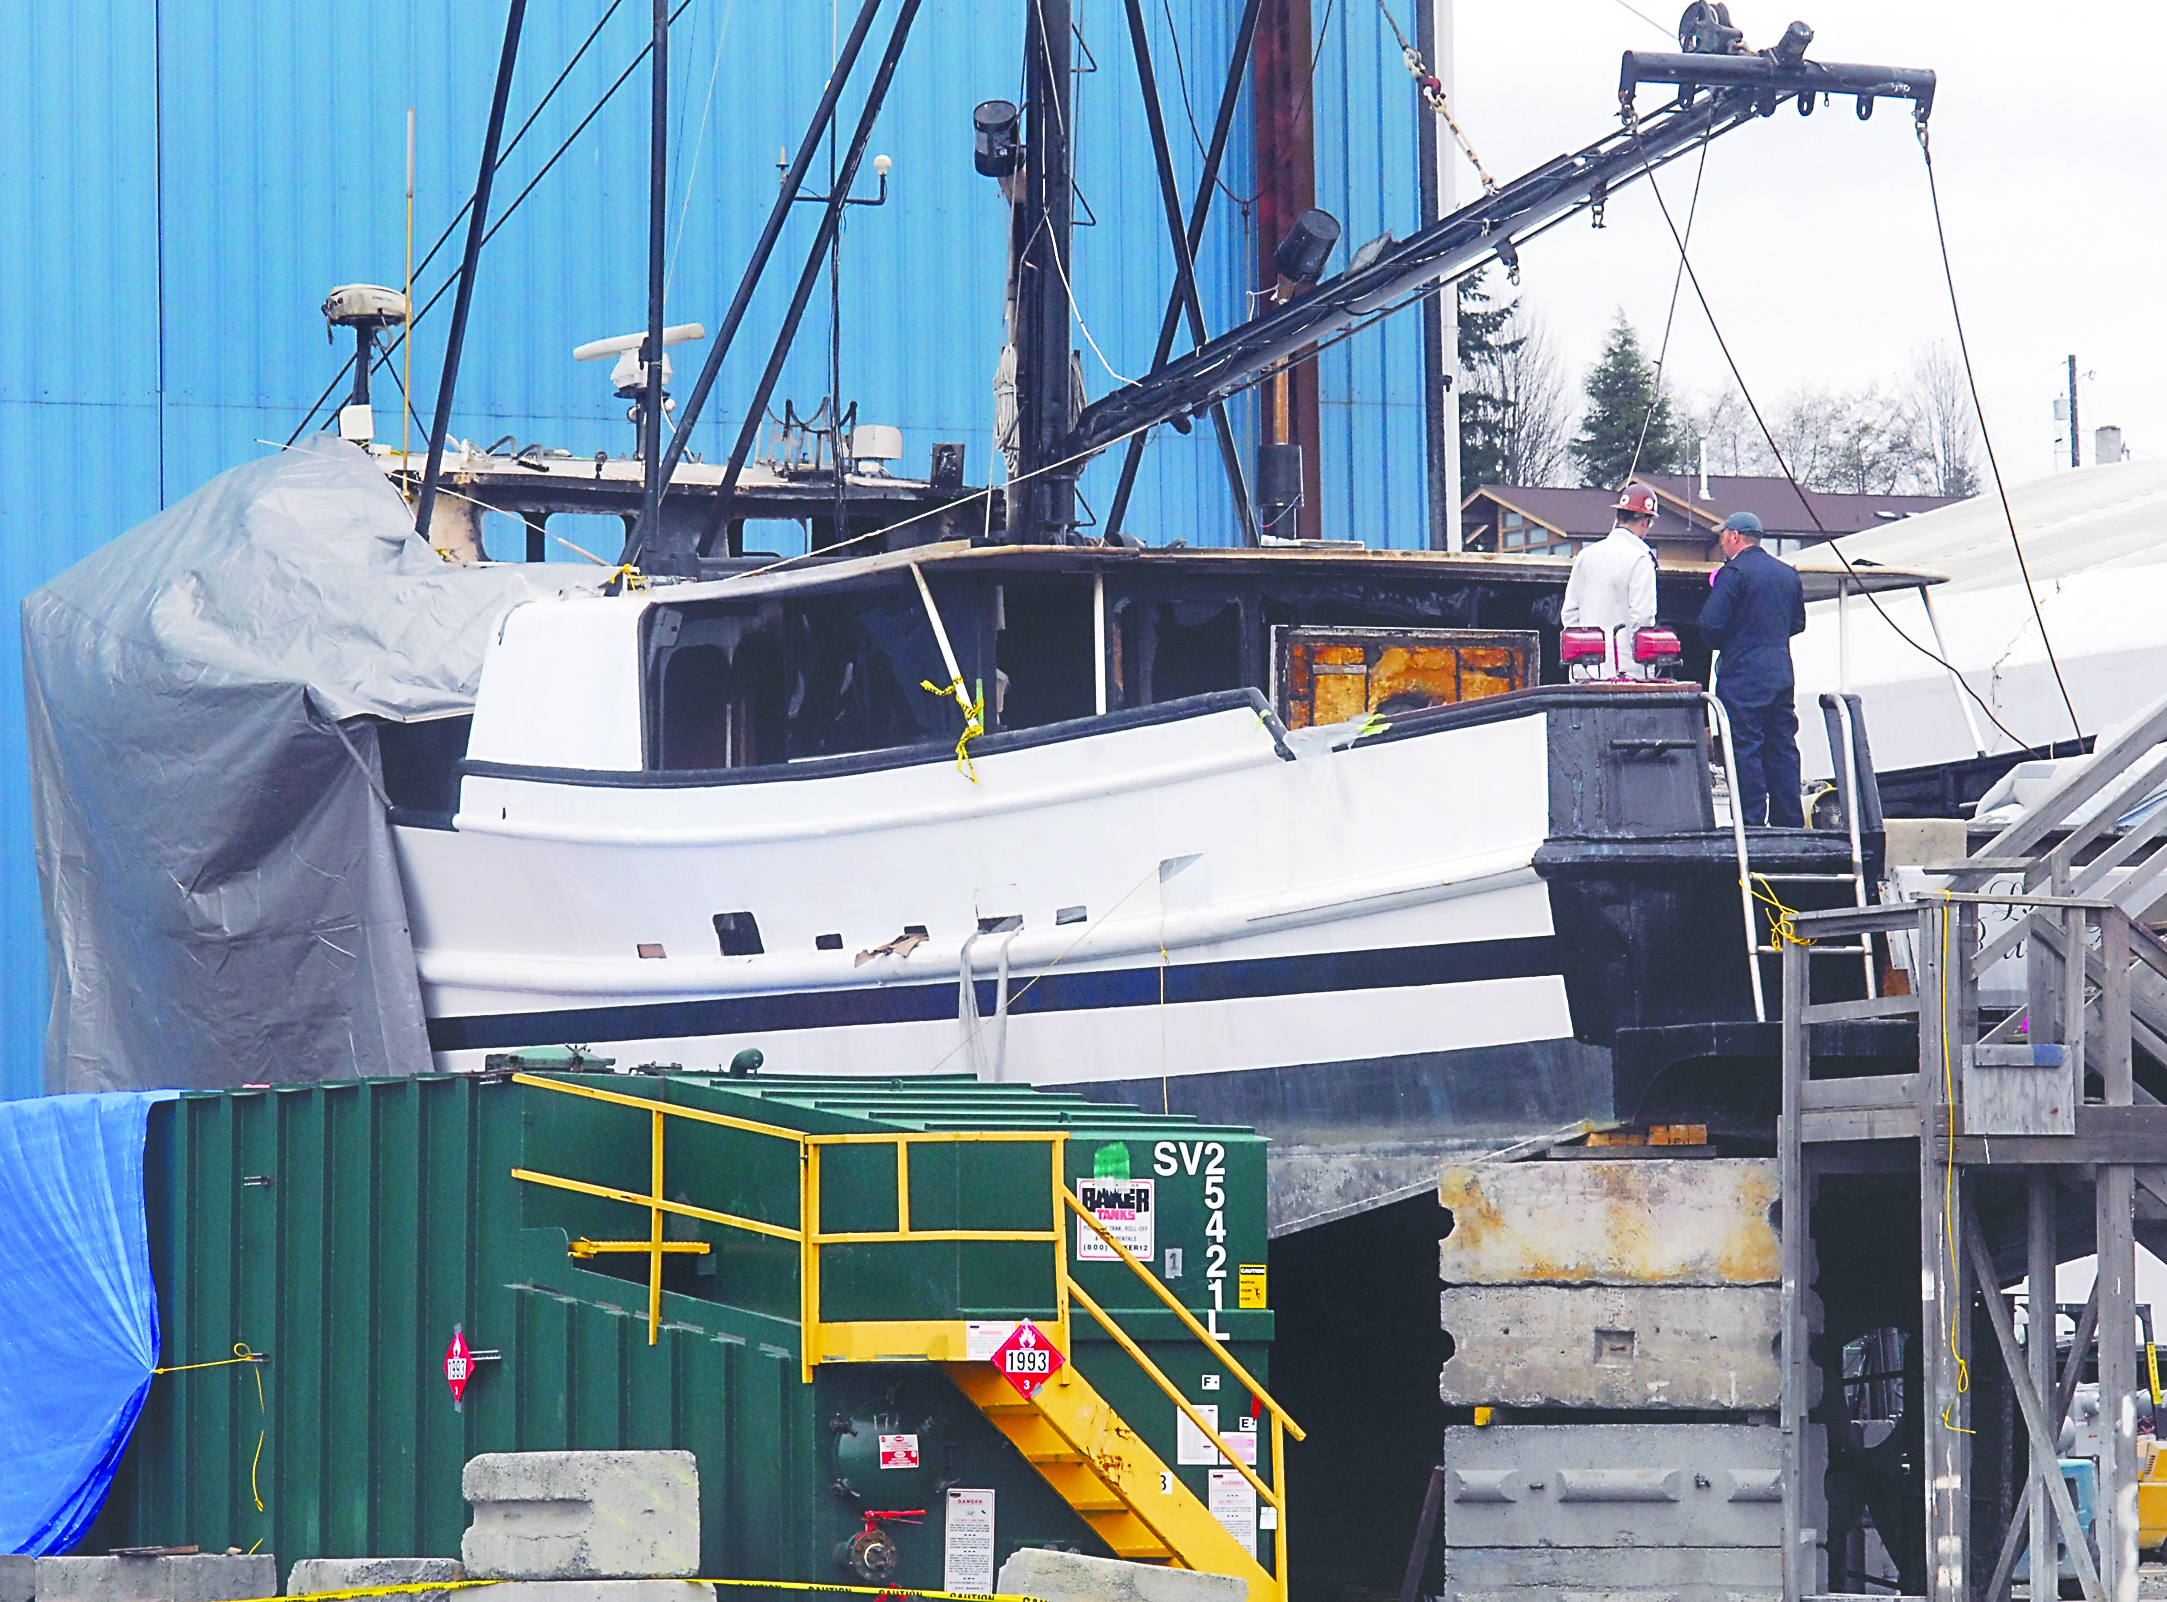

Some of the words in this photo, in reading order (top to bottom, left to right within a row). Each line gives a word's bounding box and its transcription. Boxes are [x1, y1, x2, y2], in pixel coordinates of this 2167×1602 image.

[1082, 1187, 1149, 1213] BAKER
[1096, 1209, 1136, 1221] TANKS
[1008, 1351, 1047, 1372] 1993
[448, 1360, 466, 1379] 1993
[1023, 1379, 1031, 1391] 3
[1203, 1376, 1212, 1387] F
[1241, 1418, 1250, 1429] E
